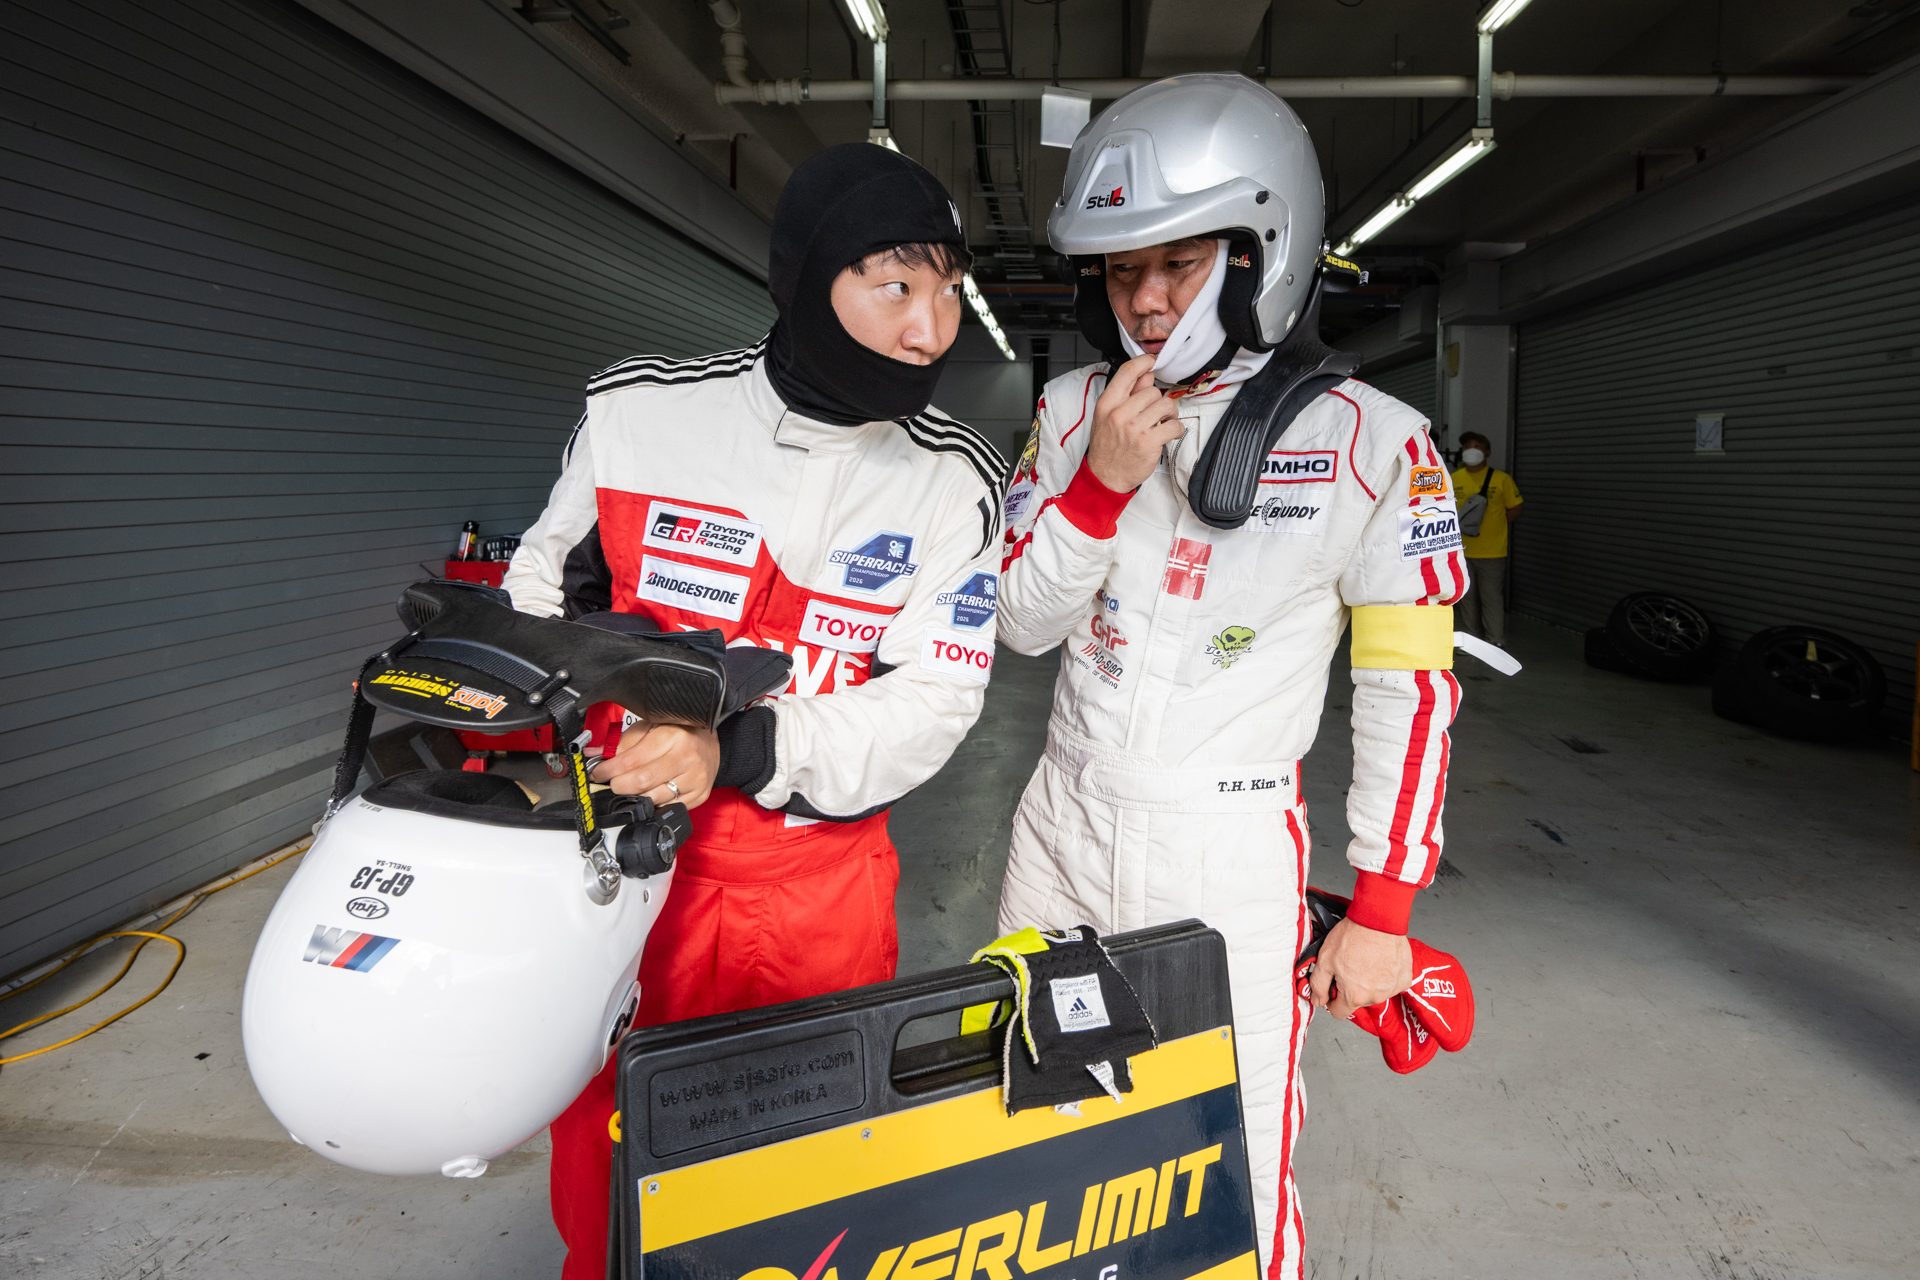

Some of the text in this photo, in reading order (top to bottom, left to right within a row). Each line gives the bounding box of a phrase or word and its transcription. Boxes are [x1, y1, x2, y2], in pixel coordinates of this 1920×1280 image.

[1086, 188, 1126, 210] Stilo
[1228, 255, 1251, 268] Stilo
[1261, 459, 1330, 474] UMHO
[1412, 471, 1443, 491] Simon
[1268, 506, 1320, 520] BUDDY
[651, 522, 696, 543] GR
[699, 530, 747, 546] GAZOO
[704, 521, 755, 540] TOYOTA
[1410, 518, 1456, 540] KARA
[695, 537, 743, 555] Racing
[831, 551, 920, 576] SUPERRACE
[850, 567, 890, 578] CHAMPIONSHIP
[645, 571, 740, 605] BRIDGESTONE
[937, 593, 997, 610] SUPERRAC
[957, 606, 989, 616] CHAMPIONSHIP
[814, 614, 888, 642] TOYOT
[385, 669, 460, 688] RACING
[448, 689, 509, 720] hans
[1217, 780, 1246, 792] T.H.
[1250, 778, 1276, 791] Kim
[376, 859, 412, 872] SNELL-SA
[350, 866, 415, 897] GP-J3
[351, 901, 386, 918] Arai
[1068, 1010, 1093, 1020] adidas
[659, 1049, 855, 1108] www.sjsafe.com
[688, 1083, 828, 1130] MADE IN KOREA
